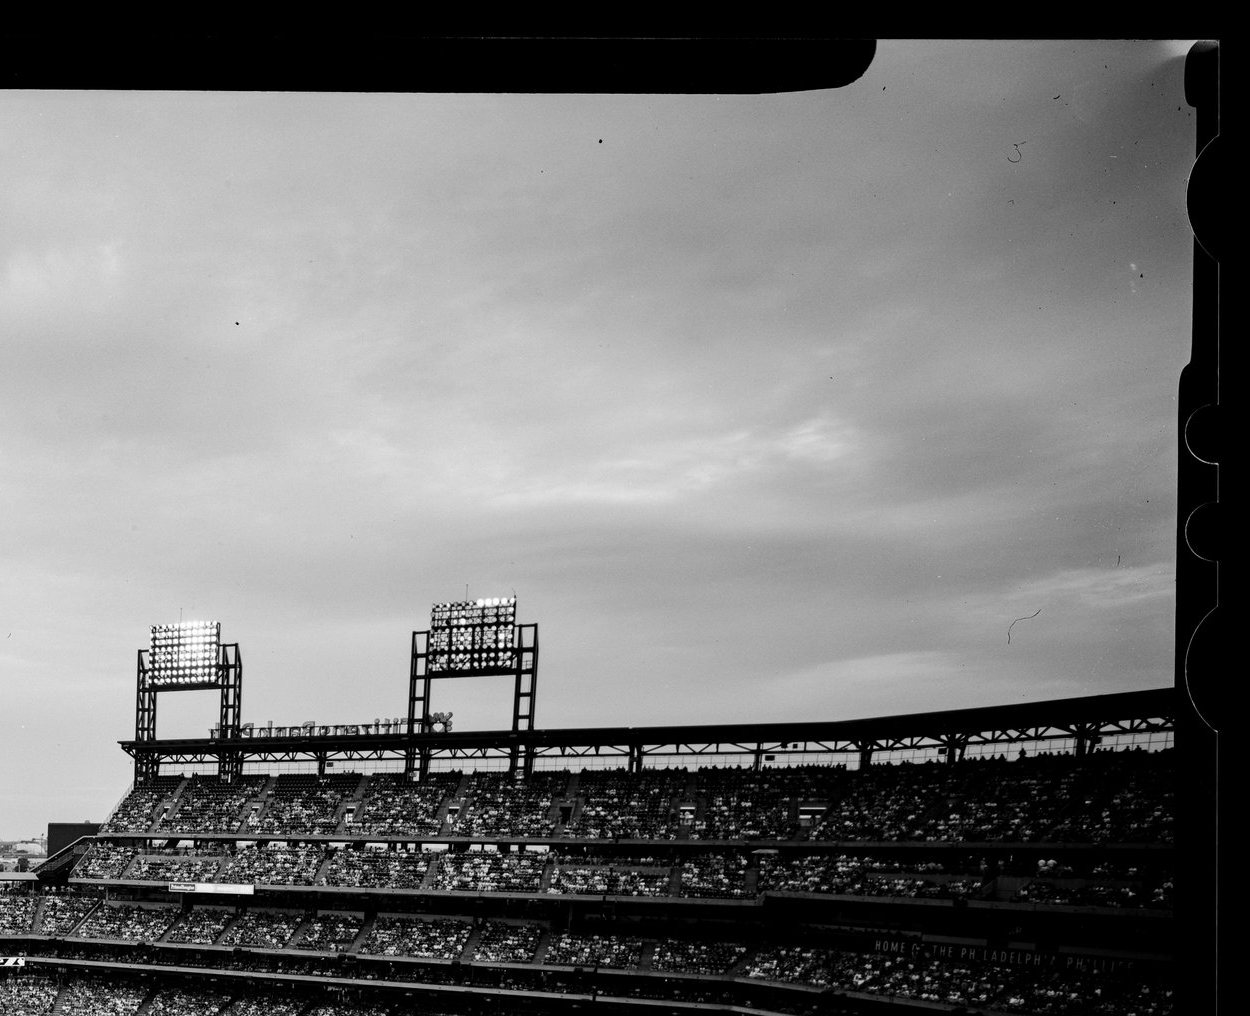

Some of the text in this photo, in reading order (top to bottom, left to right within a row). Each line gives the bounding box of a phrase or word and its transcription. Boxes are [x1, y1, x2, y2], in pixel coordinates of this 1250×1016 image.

[875, 940, 906, 953] HOME
[932, 944, 954, 958] THE
[961, 947, 1056, 966] PHLADELPHA
